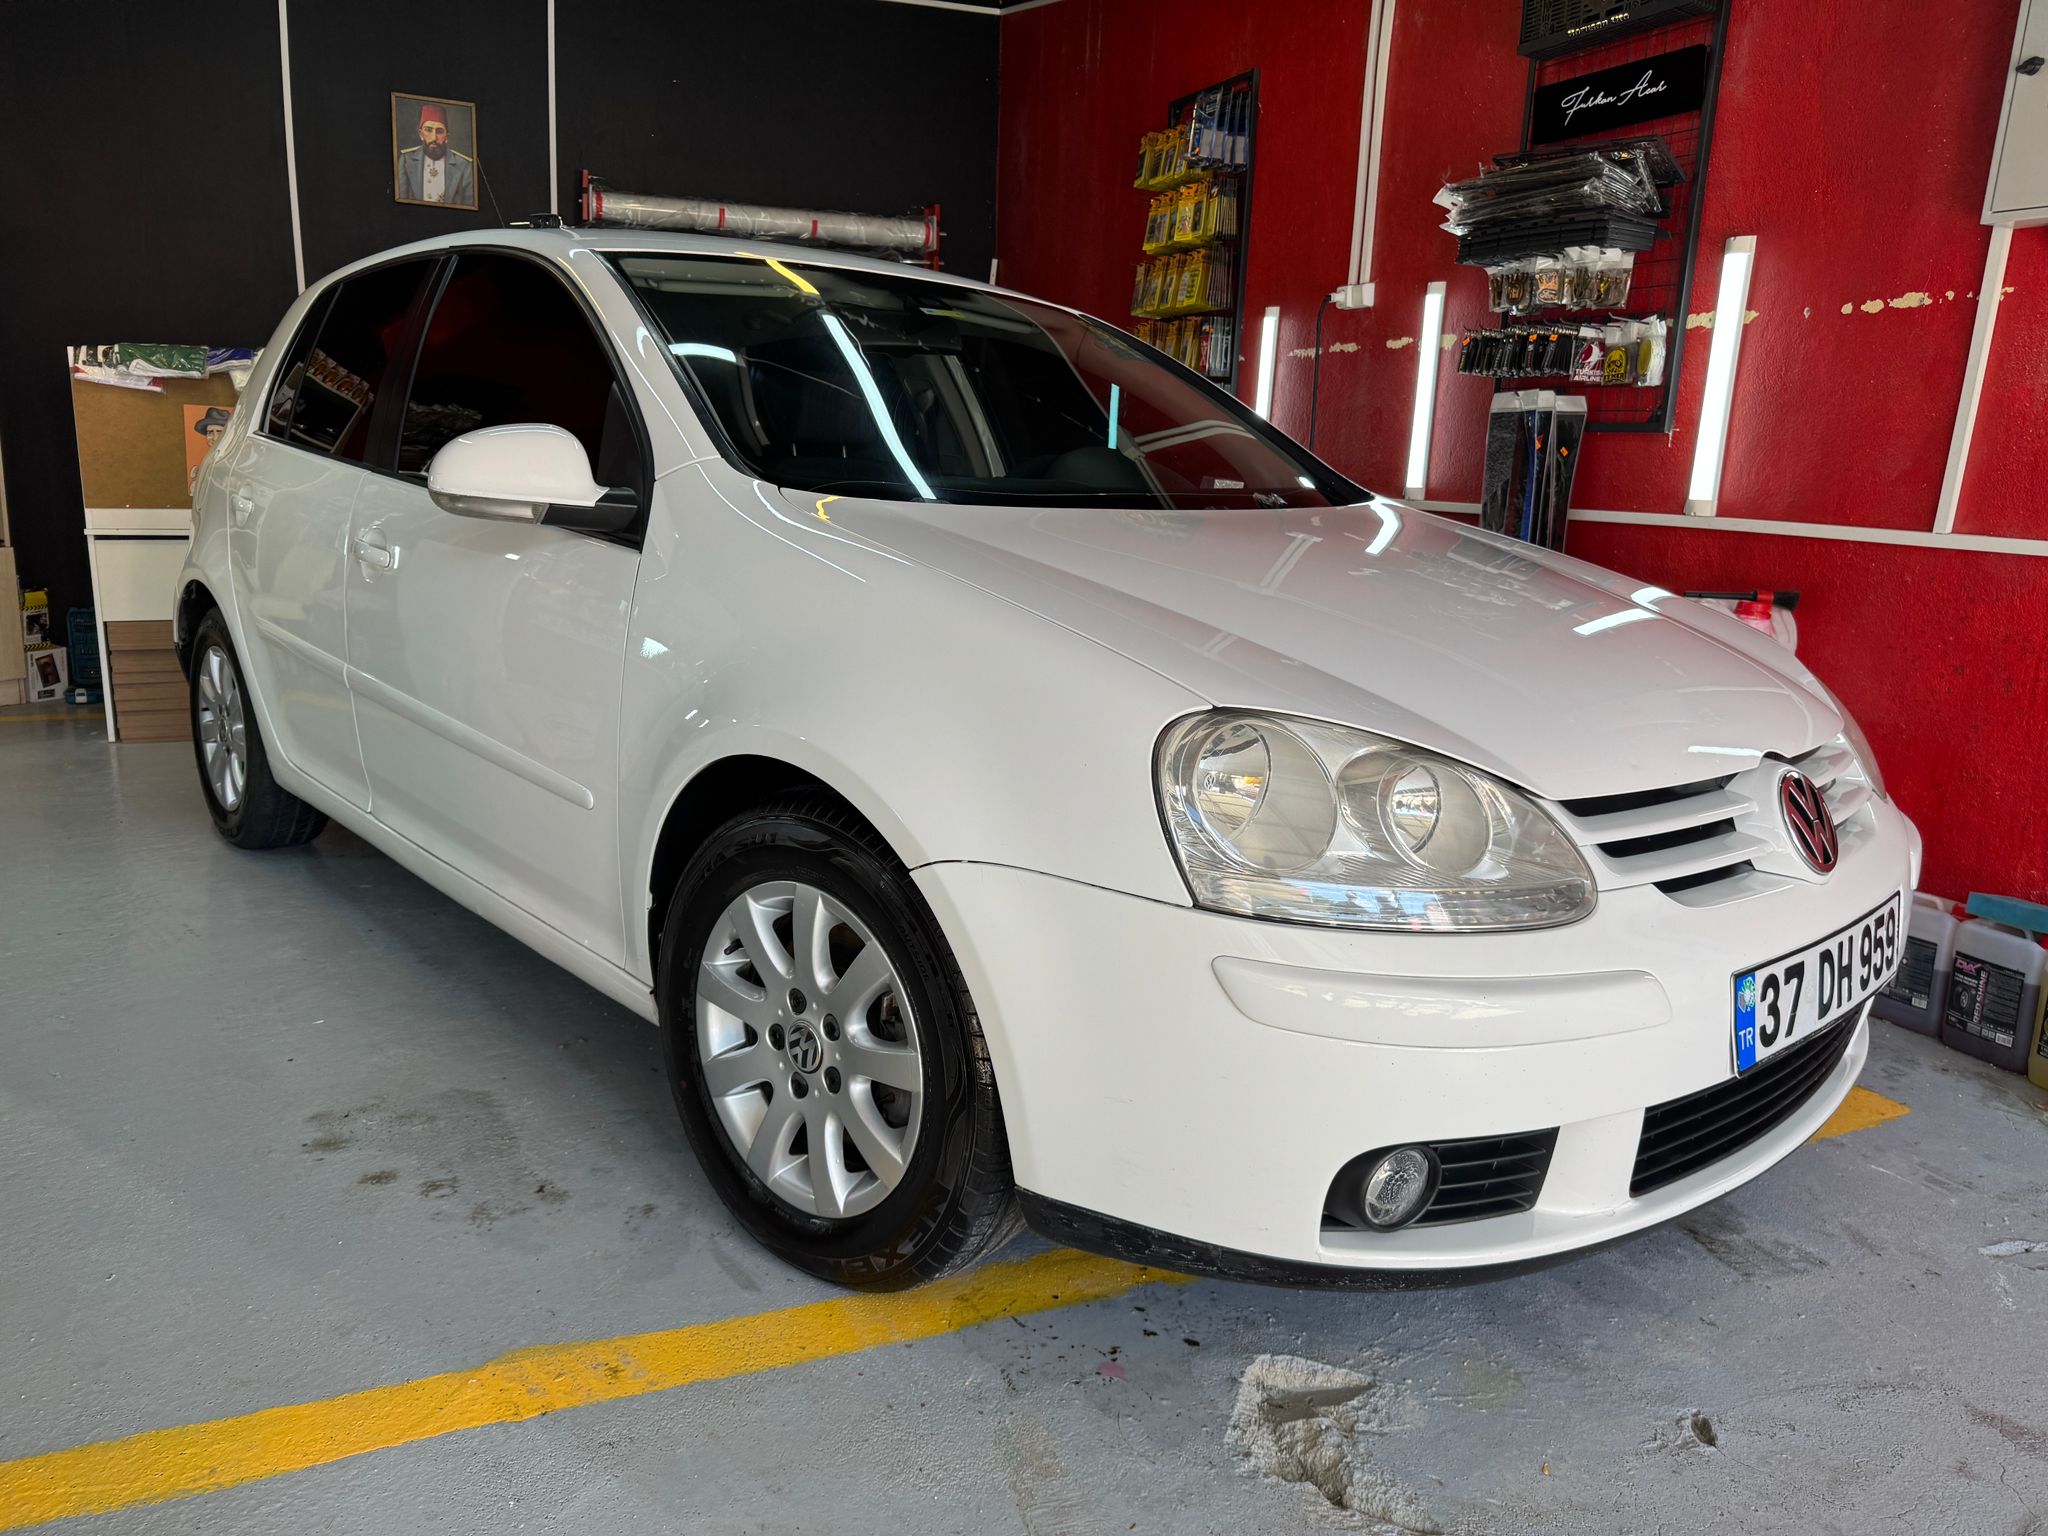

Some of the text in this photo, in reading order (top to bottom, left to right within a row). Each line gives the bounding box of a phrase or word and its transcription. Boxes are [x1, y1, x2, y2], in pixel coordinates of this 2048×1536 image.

[1758, 960, 1805, 1049] 37
[1817, 932, 1854, 1021] DH
[1859, 906, 1896, 992] 959
[1973, 970, 1989, 1024] RED SHINE
[1738, 1026, 1754, 1051] TR
